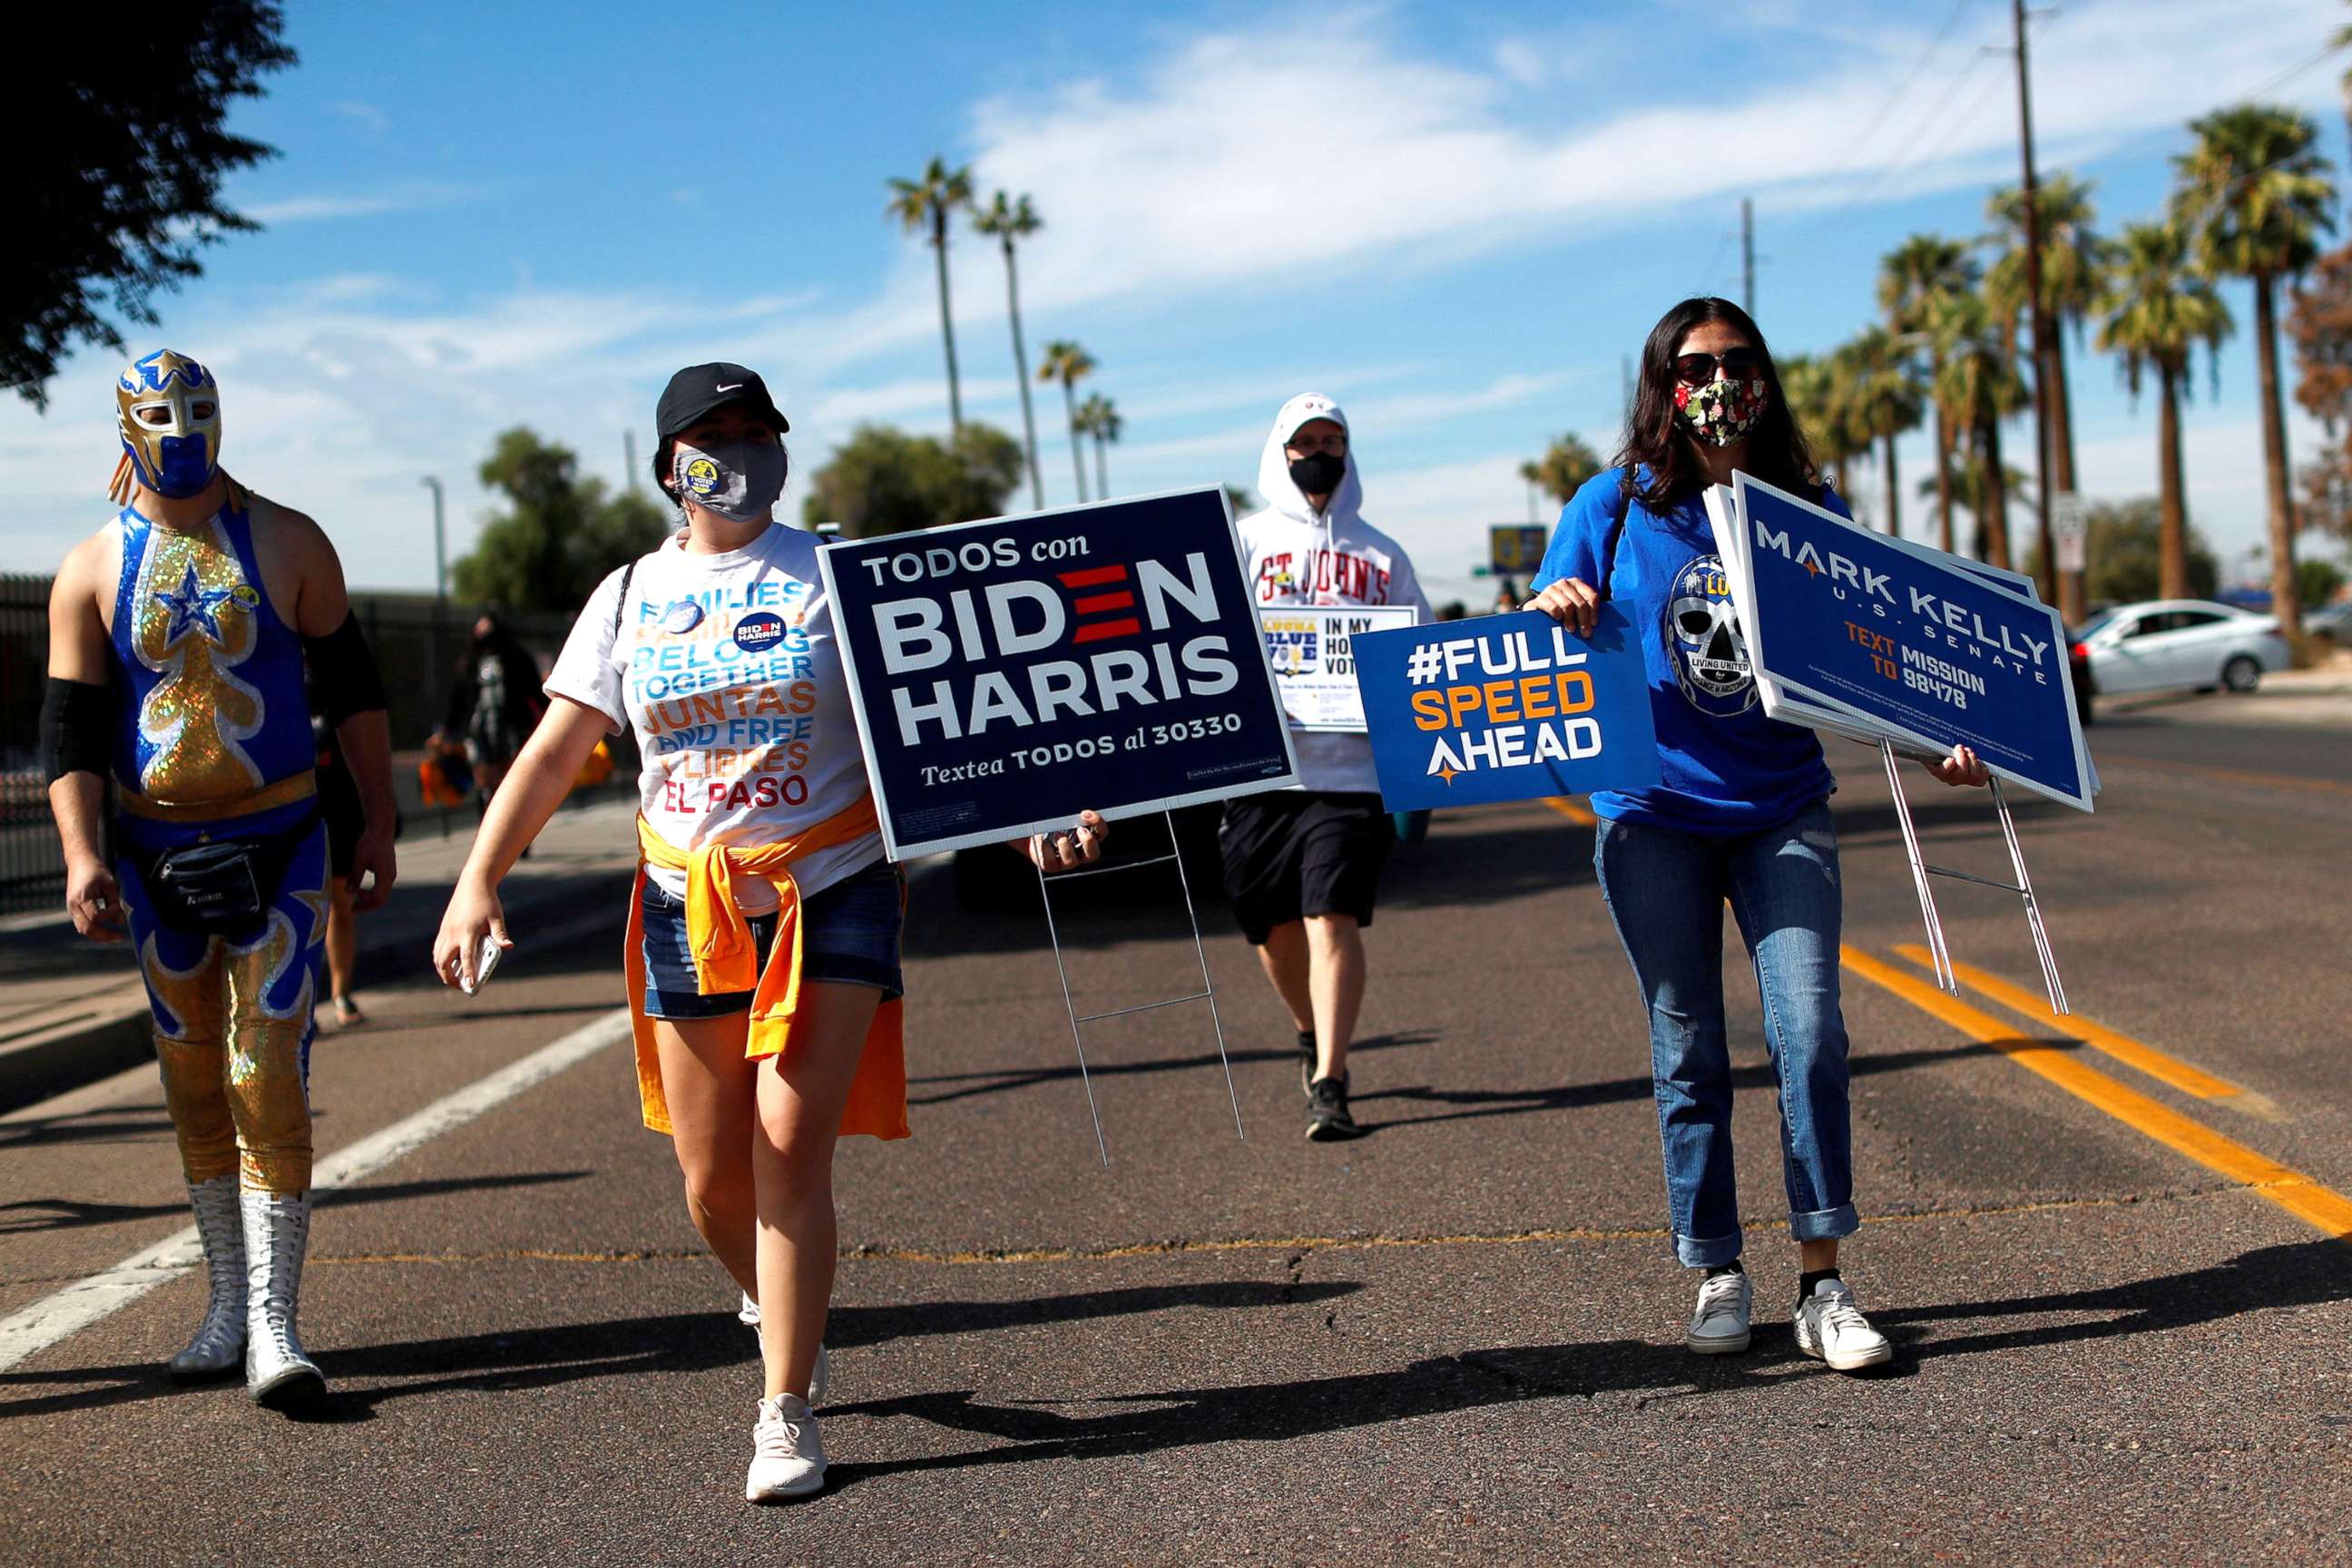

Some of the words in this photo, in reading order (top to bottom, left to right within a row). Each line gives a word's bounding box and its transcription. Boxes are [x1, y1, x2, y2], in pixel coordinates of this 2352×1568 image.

[861, 538, 1021, 586] TODOS
[1032, 535, 1090, 562] con
[871, 552, 1220, 674] BIDEN
[1756, 520, 1896, 604] MARK
[1909, 586, 2048, 665] KELLY
[634, 628, 810, 674] BELOG
[738, 622, 780, 636] BIDEN
[738, 630, 781, 642] HARRIS
[1326, 618, 1341, 634] IN
[1348, 618, 1371, 633] MY
[1833, 586, 1902, 624] U.S.
[1925, 625, 2047, 685] SENATE
[632, 655, 816, 703] TOGETHER
[1406, 626, 1588, 685] #FULL
[1691, 658, 1719, 669] LIVING
[1720, 662, 1749, 671] UNITED
[1844, 621, 1895, 657] TEXT
[1901, 644, 1985, 696] MISSION
[1870, 654, 1898, 681] TO
[1903, 667, 1966, 710] 98478
[643, 681, 816, 735] JUNTAS
[892, 635, 1240, 746] HARRIS
[1411, 670, 1595, 731] SPEED
[657, 724, 718, 752] AND
[729, 716, 814, 745] FREE
[684, 741, 809, 778] LIBRES
[921, 757, 1004, 786] Textea
[1011, 736, 1115, 769] TODOS
[1124, 728, 1146, 750] al
[1152, 713, 1241, 745] 30330
[1426, 717, 1602, 776] AHEAD
[664, 779, 696, 814] EL
[705, 775, 808, 813] PASO
